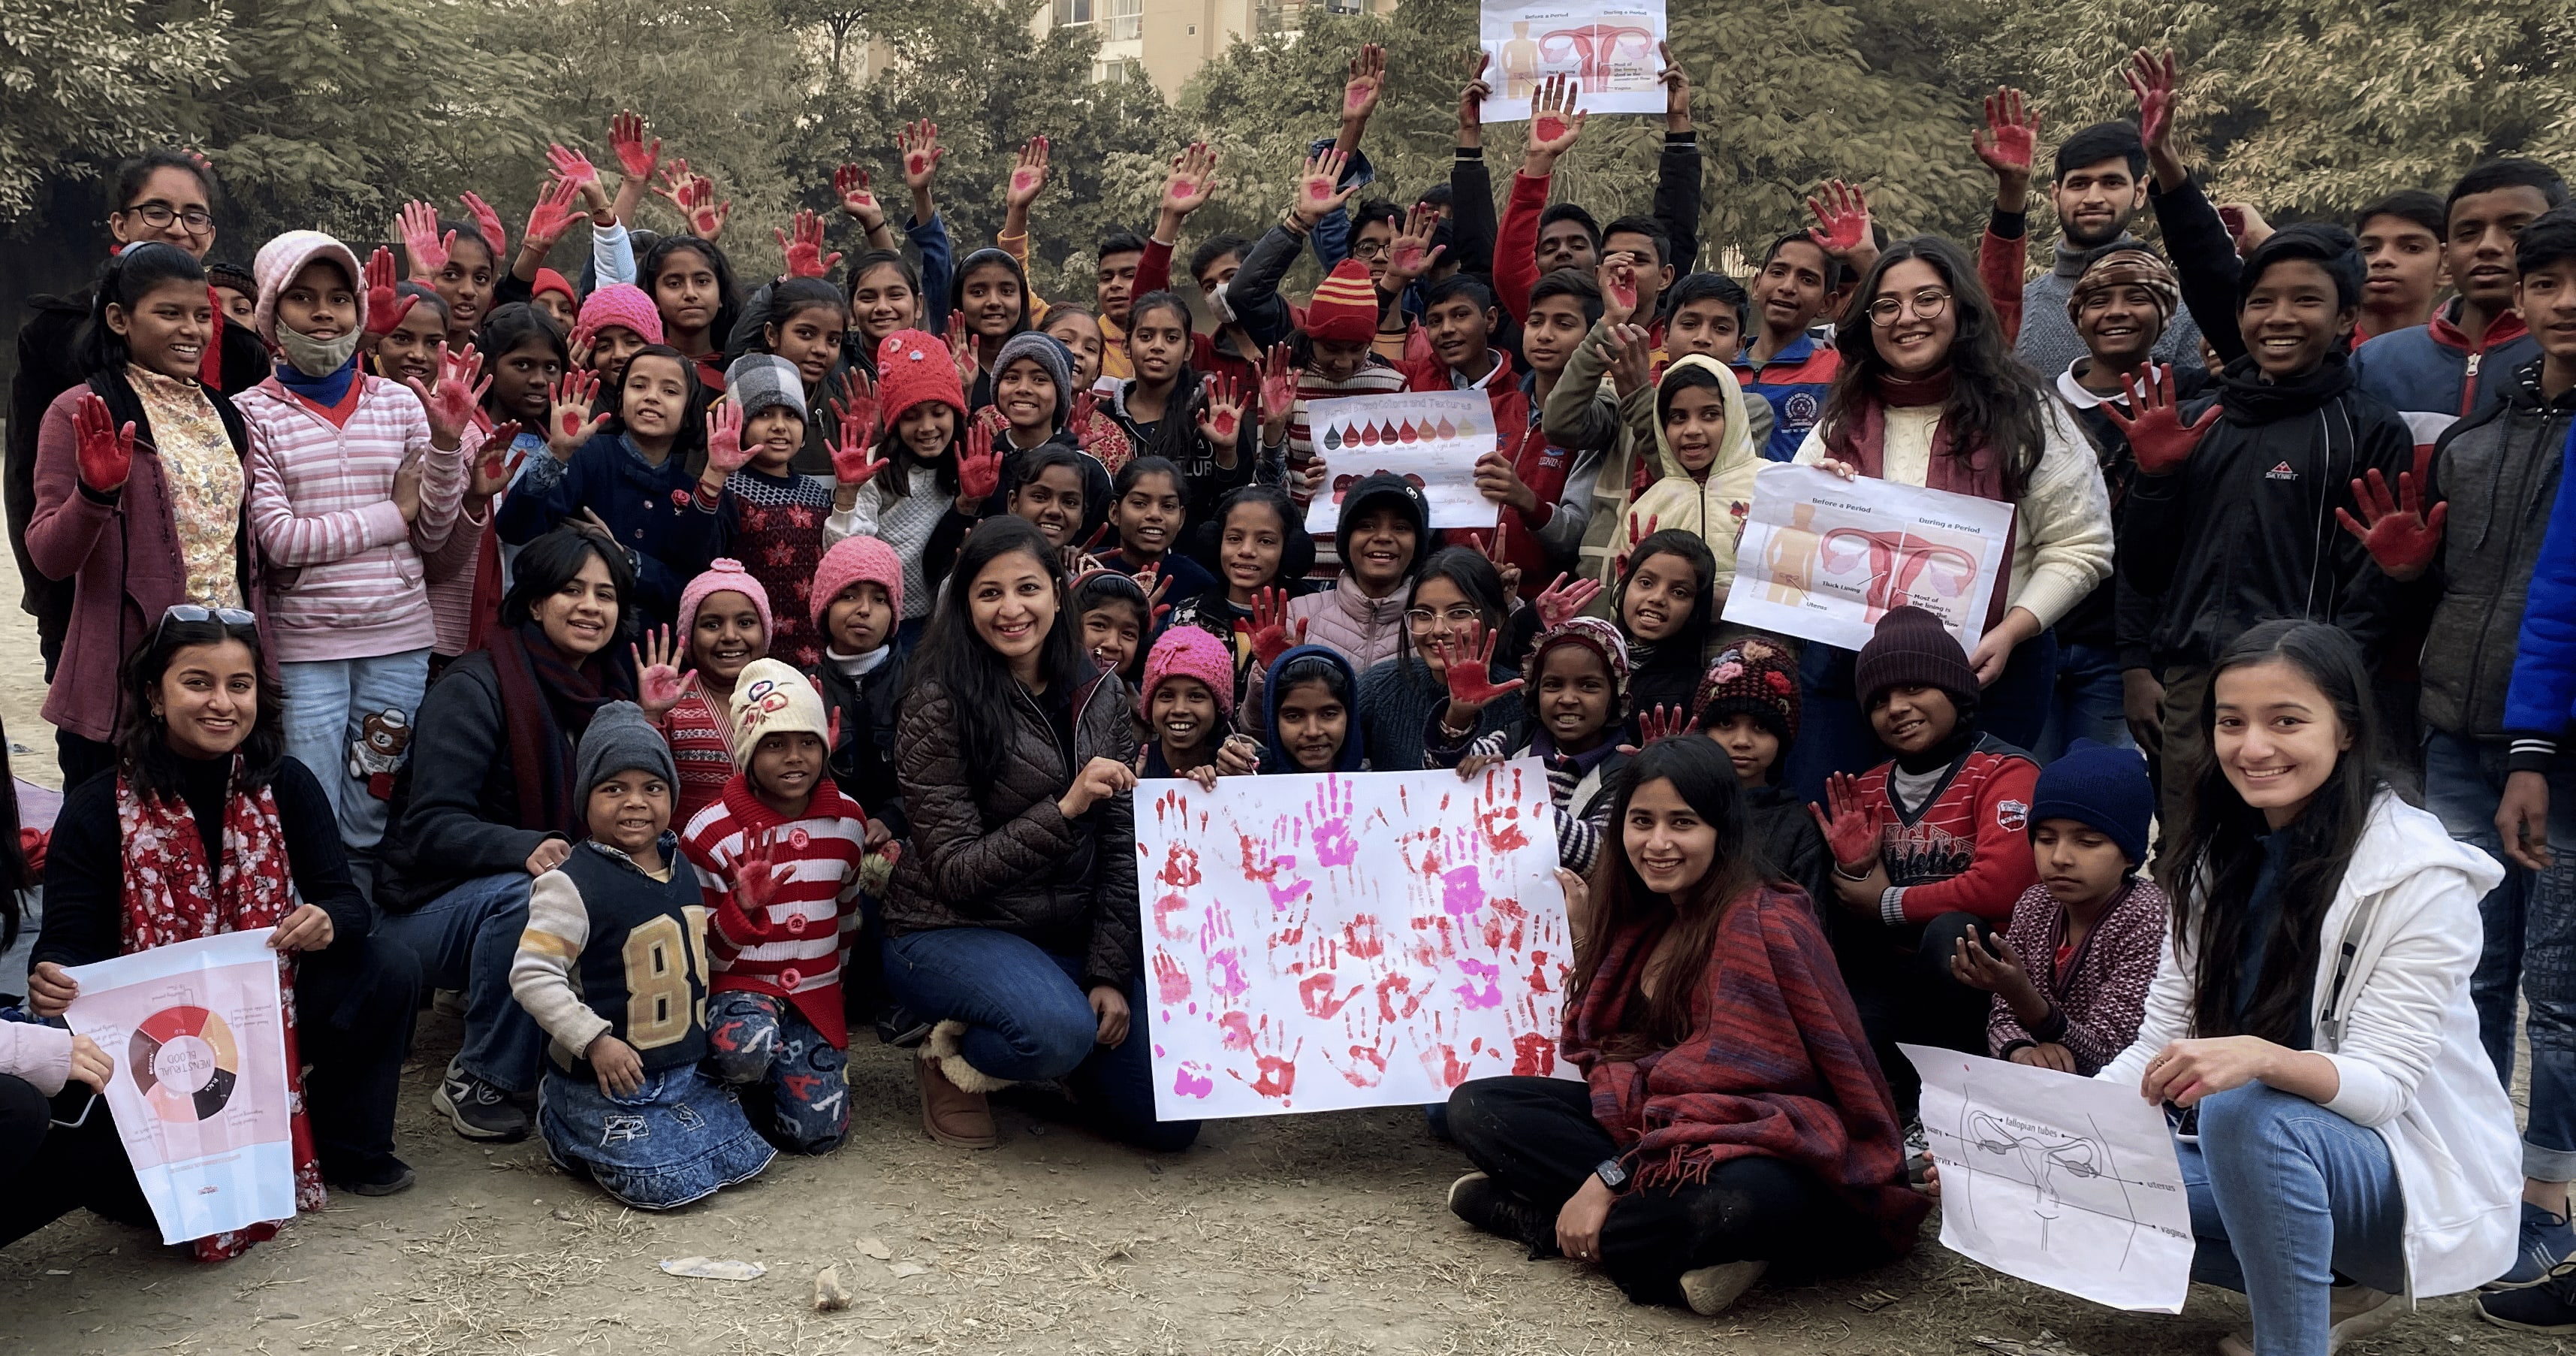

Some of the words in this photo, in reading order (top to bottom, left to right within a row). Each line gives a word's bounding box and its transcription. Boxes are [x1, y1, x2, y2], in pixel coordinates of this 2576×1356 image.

[2265, 472, 2299, 481] SKYNET
[1812, 497, 1838, 507] Before
[1846, 503, 1872, 513] Period
[1919, 517, 1946, 528] During
[1954, 524, 1980, 534] Period
[1823, 581, 1839, 589] Thick
[1840, 584, 1861, 593] Lining
[1806, 601, 1827, 611] Uterus
[1924, 602, 1944, 612] lining
[167, 1049, 197, 1063] BLOOD
[158, 1057, 211, 1077] MENSTRUAL
[2005, 1116, 2036, 1133] fallopian
[2037, 1126, 2058, 1138] tubes
[1934, 1155, 1951, 1167] ervix
[2146, 1181, 2176, 1192] uterus
[2160, 1225, 2188, 1240] vagina
